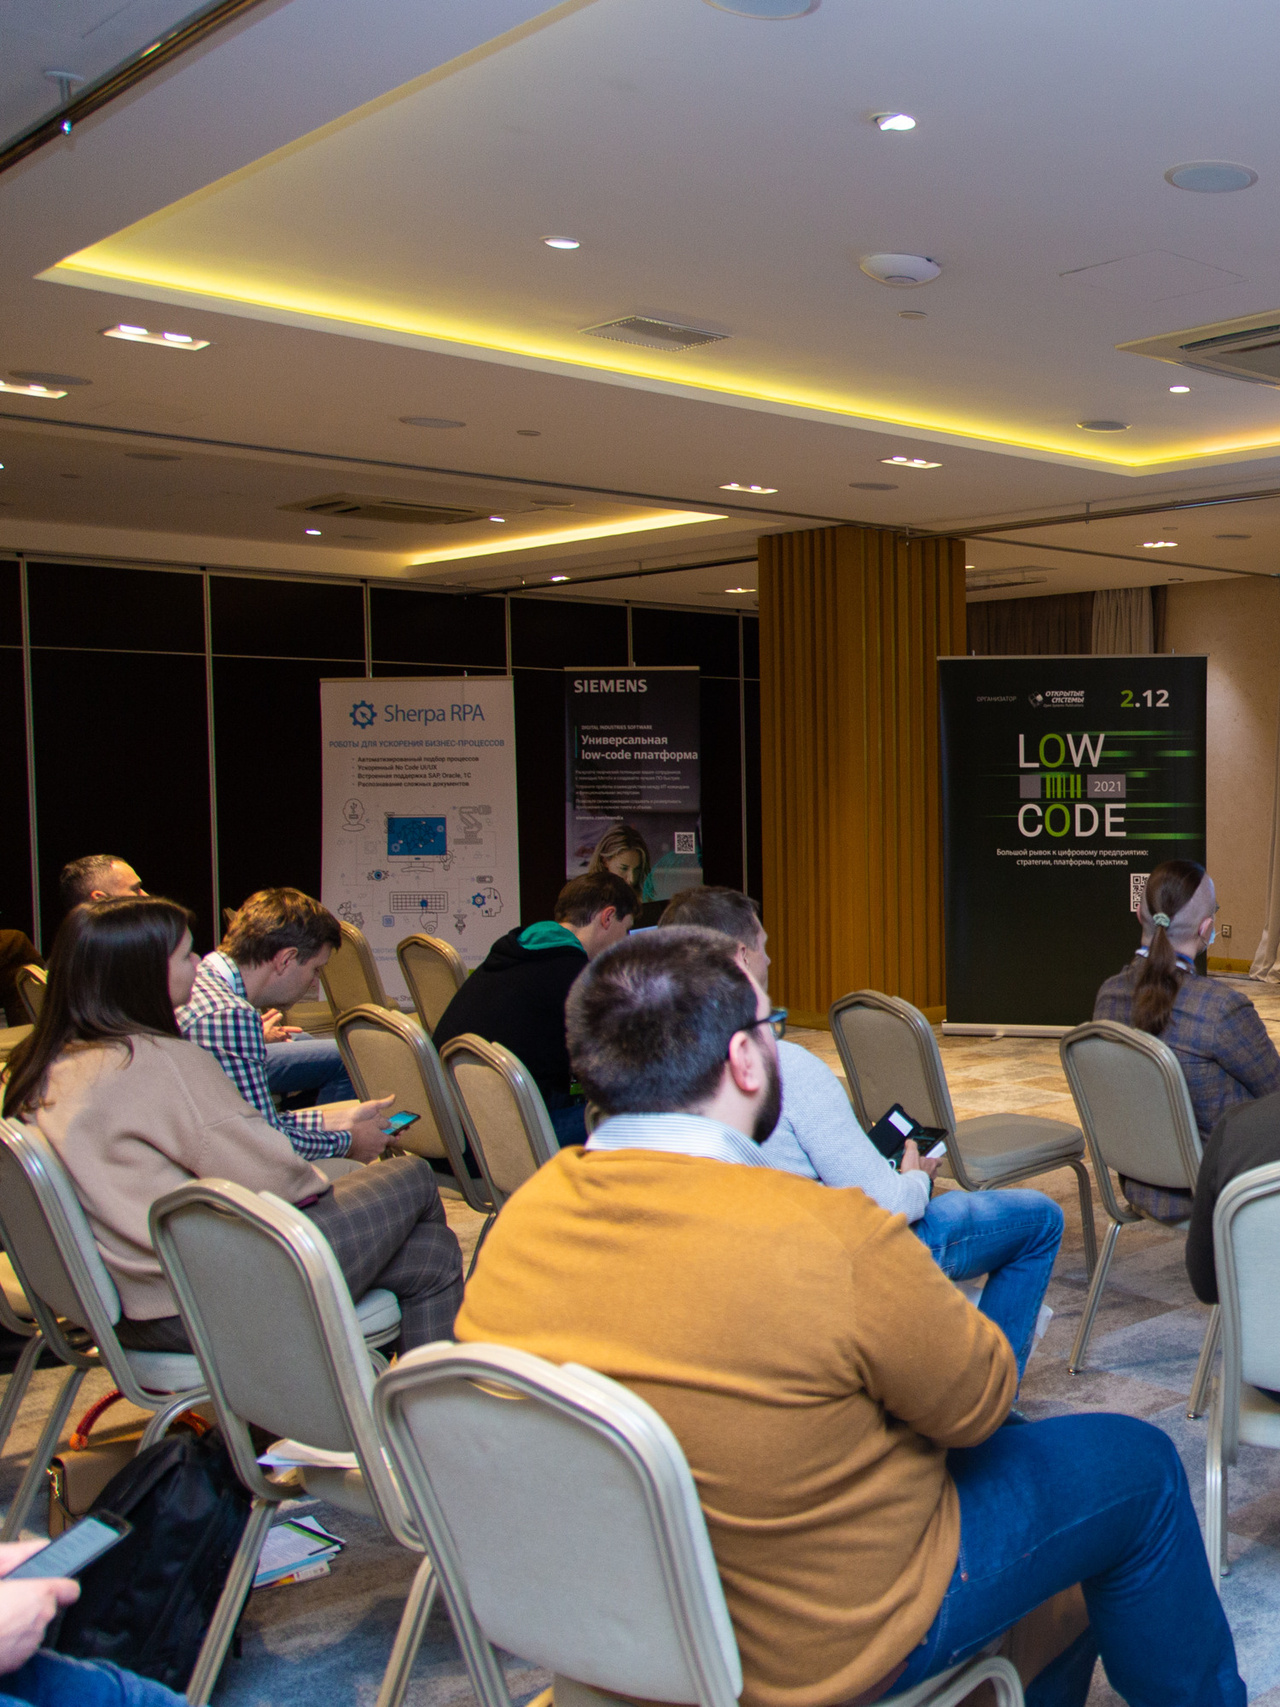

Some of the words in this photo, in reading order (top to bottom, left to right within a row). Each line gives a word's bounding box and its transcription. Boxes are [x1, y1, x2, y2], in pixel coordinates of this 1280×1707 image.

[573, 679, 648, 693] SIEMENS
[1045, 690, 1085, 698] ОТКРЫТЫЕ
[1120, 690, 1170, 707] 2.12
[384, 704, 446, 726] Sherpa
[451, 704, 485, 722] RPA
[329, 740, 360, 748] РОБОТЫ
[361, 740, 378, 748] ДЛЯ
[379, 740, 424, 748] УСКОРЕНИЯ
[425, 739, 505, 748] БИЗНЕС-ПРОЦЕССОВ
[581, 735, 668, 747] Универсальная
[581, 749, 632, 760] low-code
[633, 749, 699, 763] платформа
[1018, 733, 1105, 768] LOW
[1094, 781, 1122, 792] 2021
[1017, 803, 1127, 837] CODE
[996, 848, 1028, 856] Большой
[1058, 848, 1098, 857] цифровому
[1016, 859, 1053, 867] стратегии,
[1053, 858, 1095, 867] платформы,
[1095, 859, 1129, 867] практика
